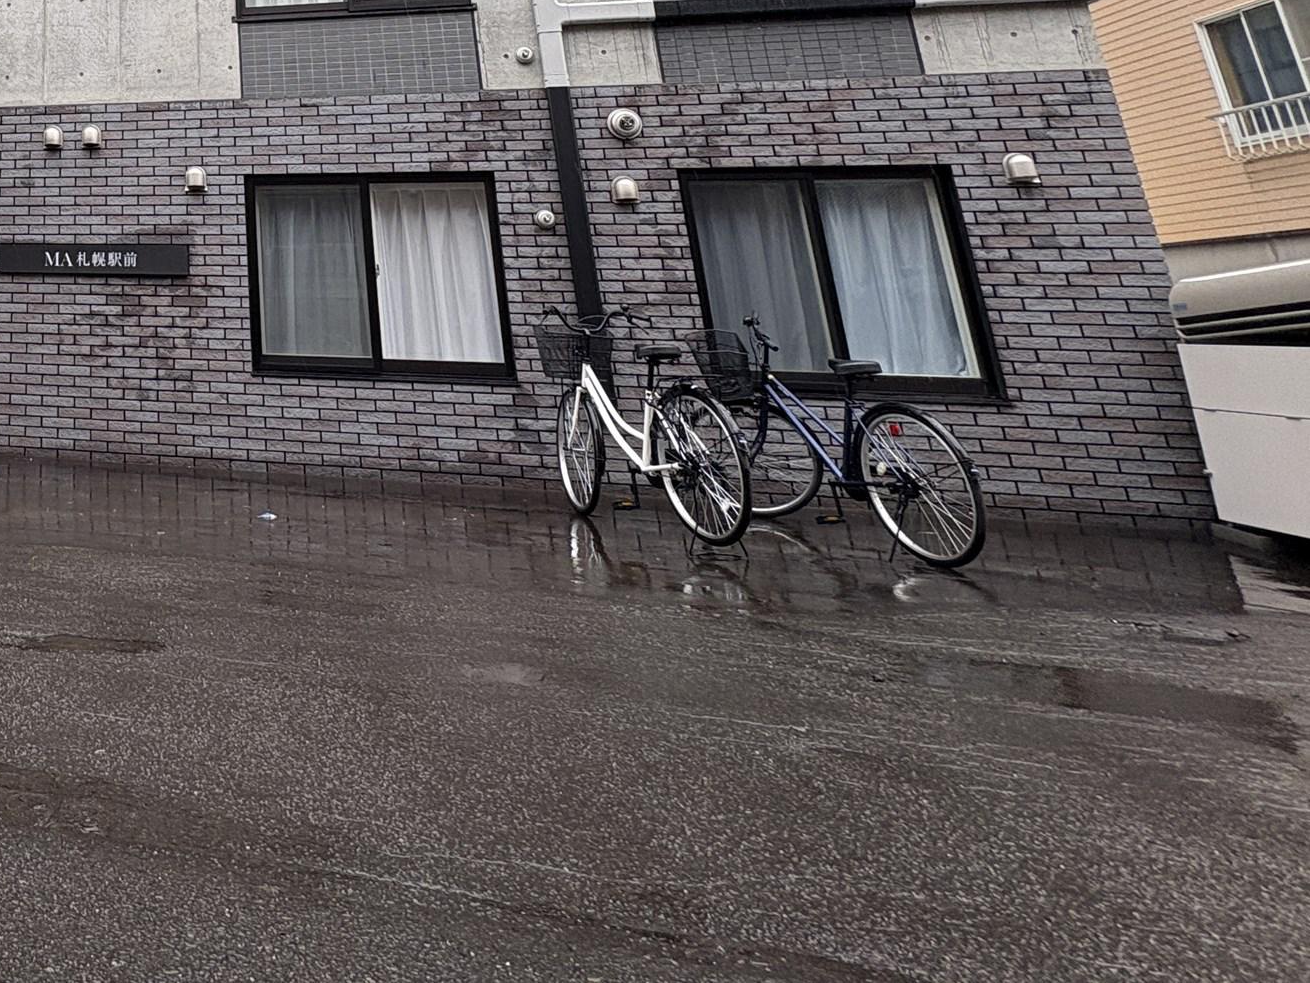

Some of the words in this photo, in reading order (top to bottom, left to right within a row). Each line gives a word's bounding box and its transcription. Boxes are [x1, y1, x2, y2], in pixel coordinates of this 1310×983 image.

[44, 251, 73, 267] MA
[76, 251, 138, 267] 札幌駅前
